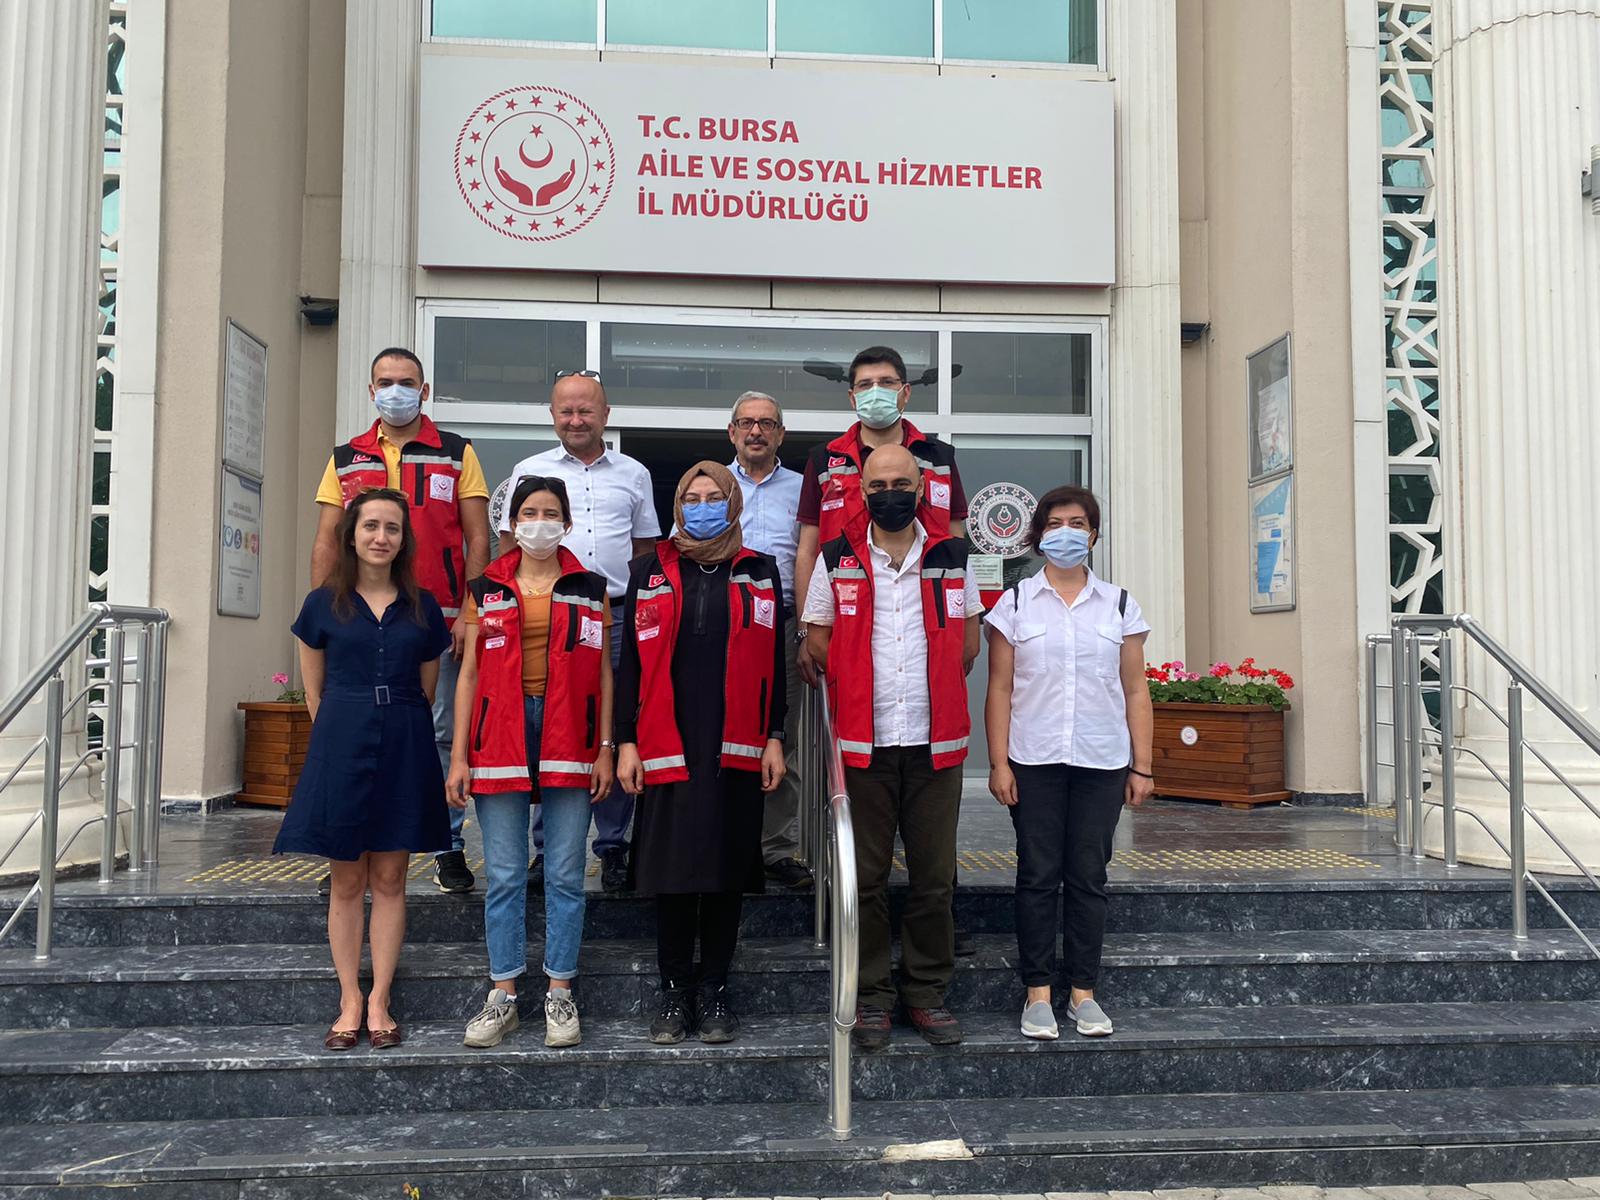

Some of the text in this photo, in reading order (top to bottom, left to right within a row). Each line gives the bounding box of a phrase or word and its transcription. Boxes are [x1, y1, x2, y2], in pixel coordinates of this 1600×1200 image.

[638, 115, 799, 144] T.C. BURSA
[637, 148, 1042, 190] AİLE VE SOSYAL HİZMETLER
[638, 186, 869, 223] İL MÜDÜRLÜĞÜ
